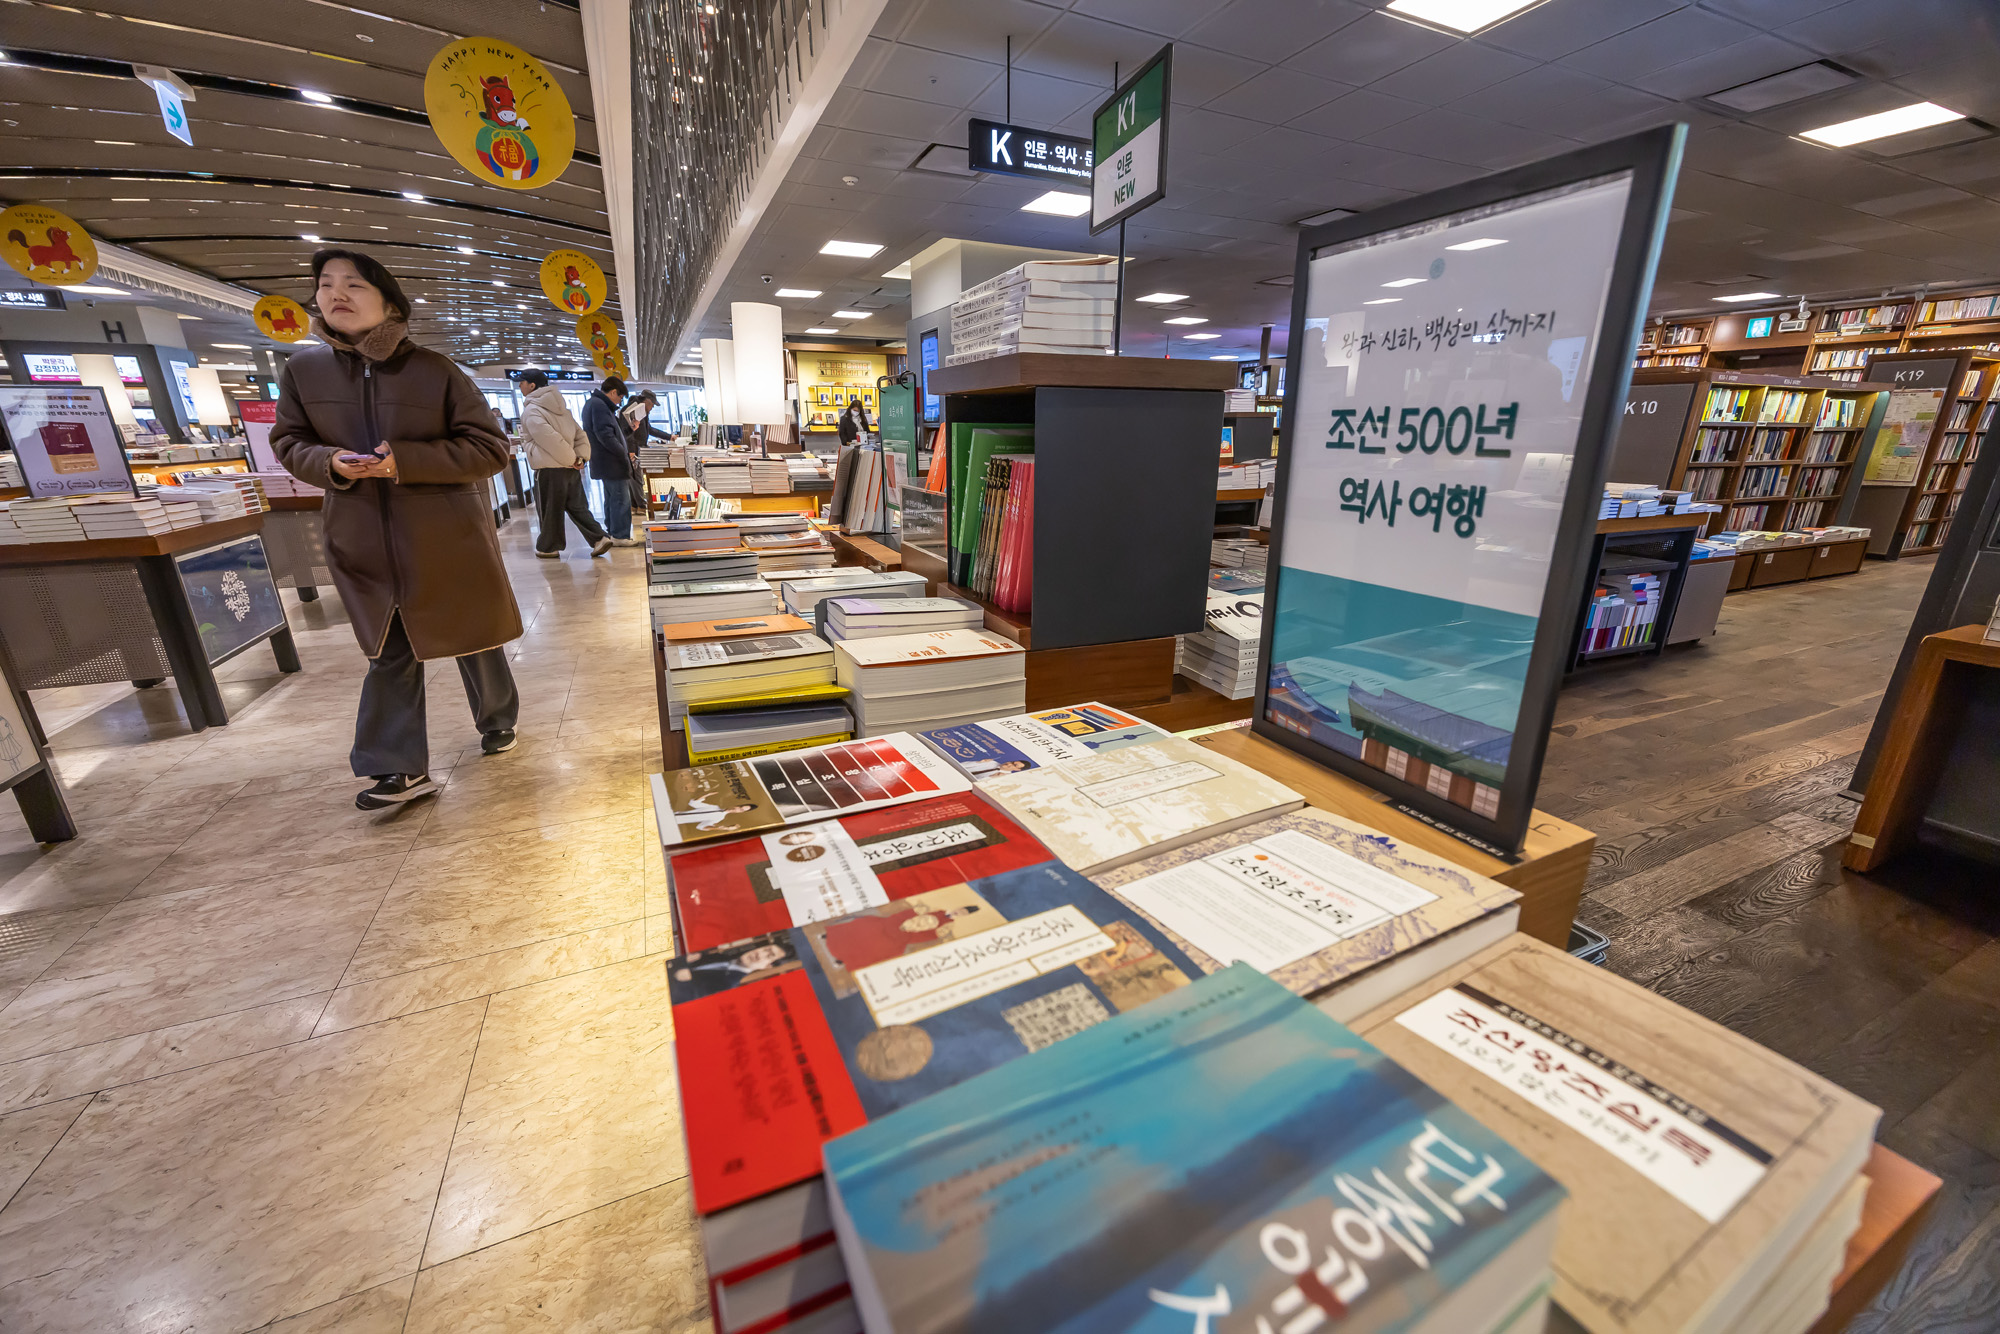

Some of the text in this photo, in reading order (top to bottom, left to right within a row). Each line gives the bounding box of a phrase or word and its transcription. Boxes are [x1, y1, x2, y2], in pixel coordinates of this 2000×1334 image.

[441, 47, 550, 91] HAPPY NEW YEAR
[1117, 90, 1136, 137] K1
[498, 144, 519, 163] 福
[991, 129, 1013, 166] K
[1116, 151, 1133, 180] 인문
[1114, 178, 1136, 207] NEW
[101, 320, 127, 343] H
[1342, 308, 1557, 359] 왕과 신하, 백성의 삶까지
[1894, 370, 1925, 382] K19
[1325, 402, 1520, 458] 조선 500년
[1339, 477, 1487, 539] 역사 여행
[905, 748, 936, 770] 설민석의
[1029, 737, 1077, 761] 한국사
[1221, 854, 1356, 926] 조선왕조실록
[891, 915, 1075, 988] 조선왕조실록
[1447, 1006, 1713, 1169] 조선왕조실록
